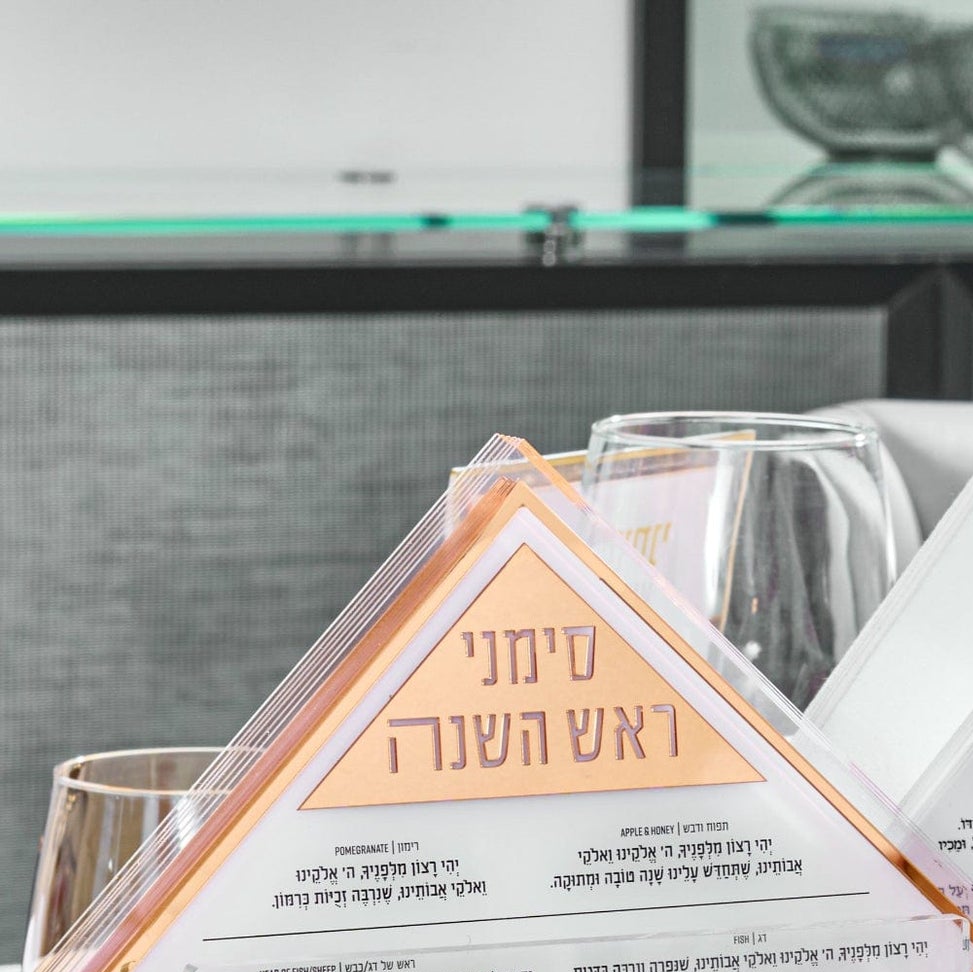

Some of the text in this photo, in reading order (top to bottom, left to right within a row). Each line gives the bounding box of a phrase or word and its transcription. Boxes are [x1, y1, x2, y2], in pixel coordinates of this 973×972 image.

[460, 625, 596, 686] סימני
[387, 703, 678, 774] ראש השנה
[620, 824, 675, 838] APPLE & HONEY
[682, 821, 729, 834] תפוח ודבש
[334, 843, 390, 857] POMEGRANATE
[396, 841, 420, 854] רימון
[733, 932, 750, 945] FISH
[757, 933, 767, 944] דג
[379, 959, 395, 971] של
[396, 959, 416, 970] ראש
